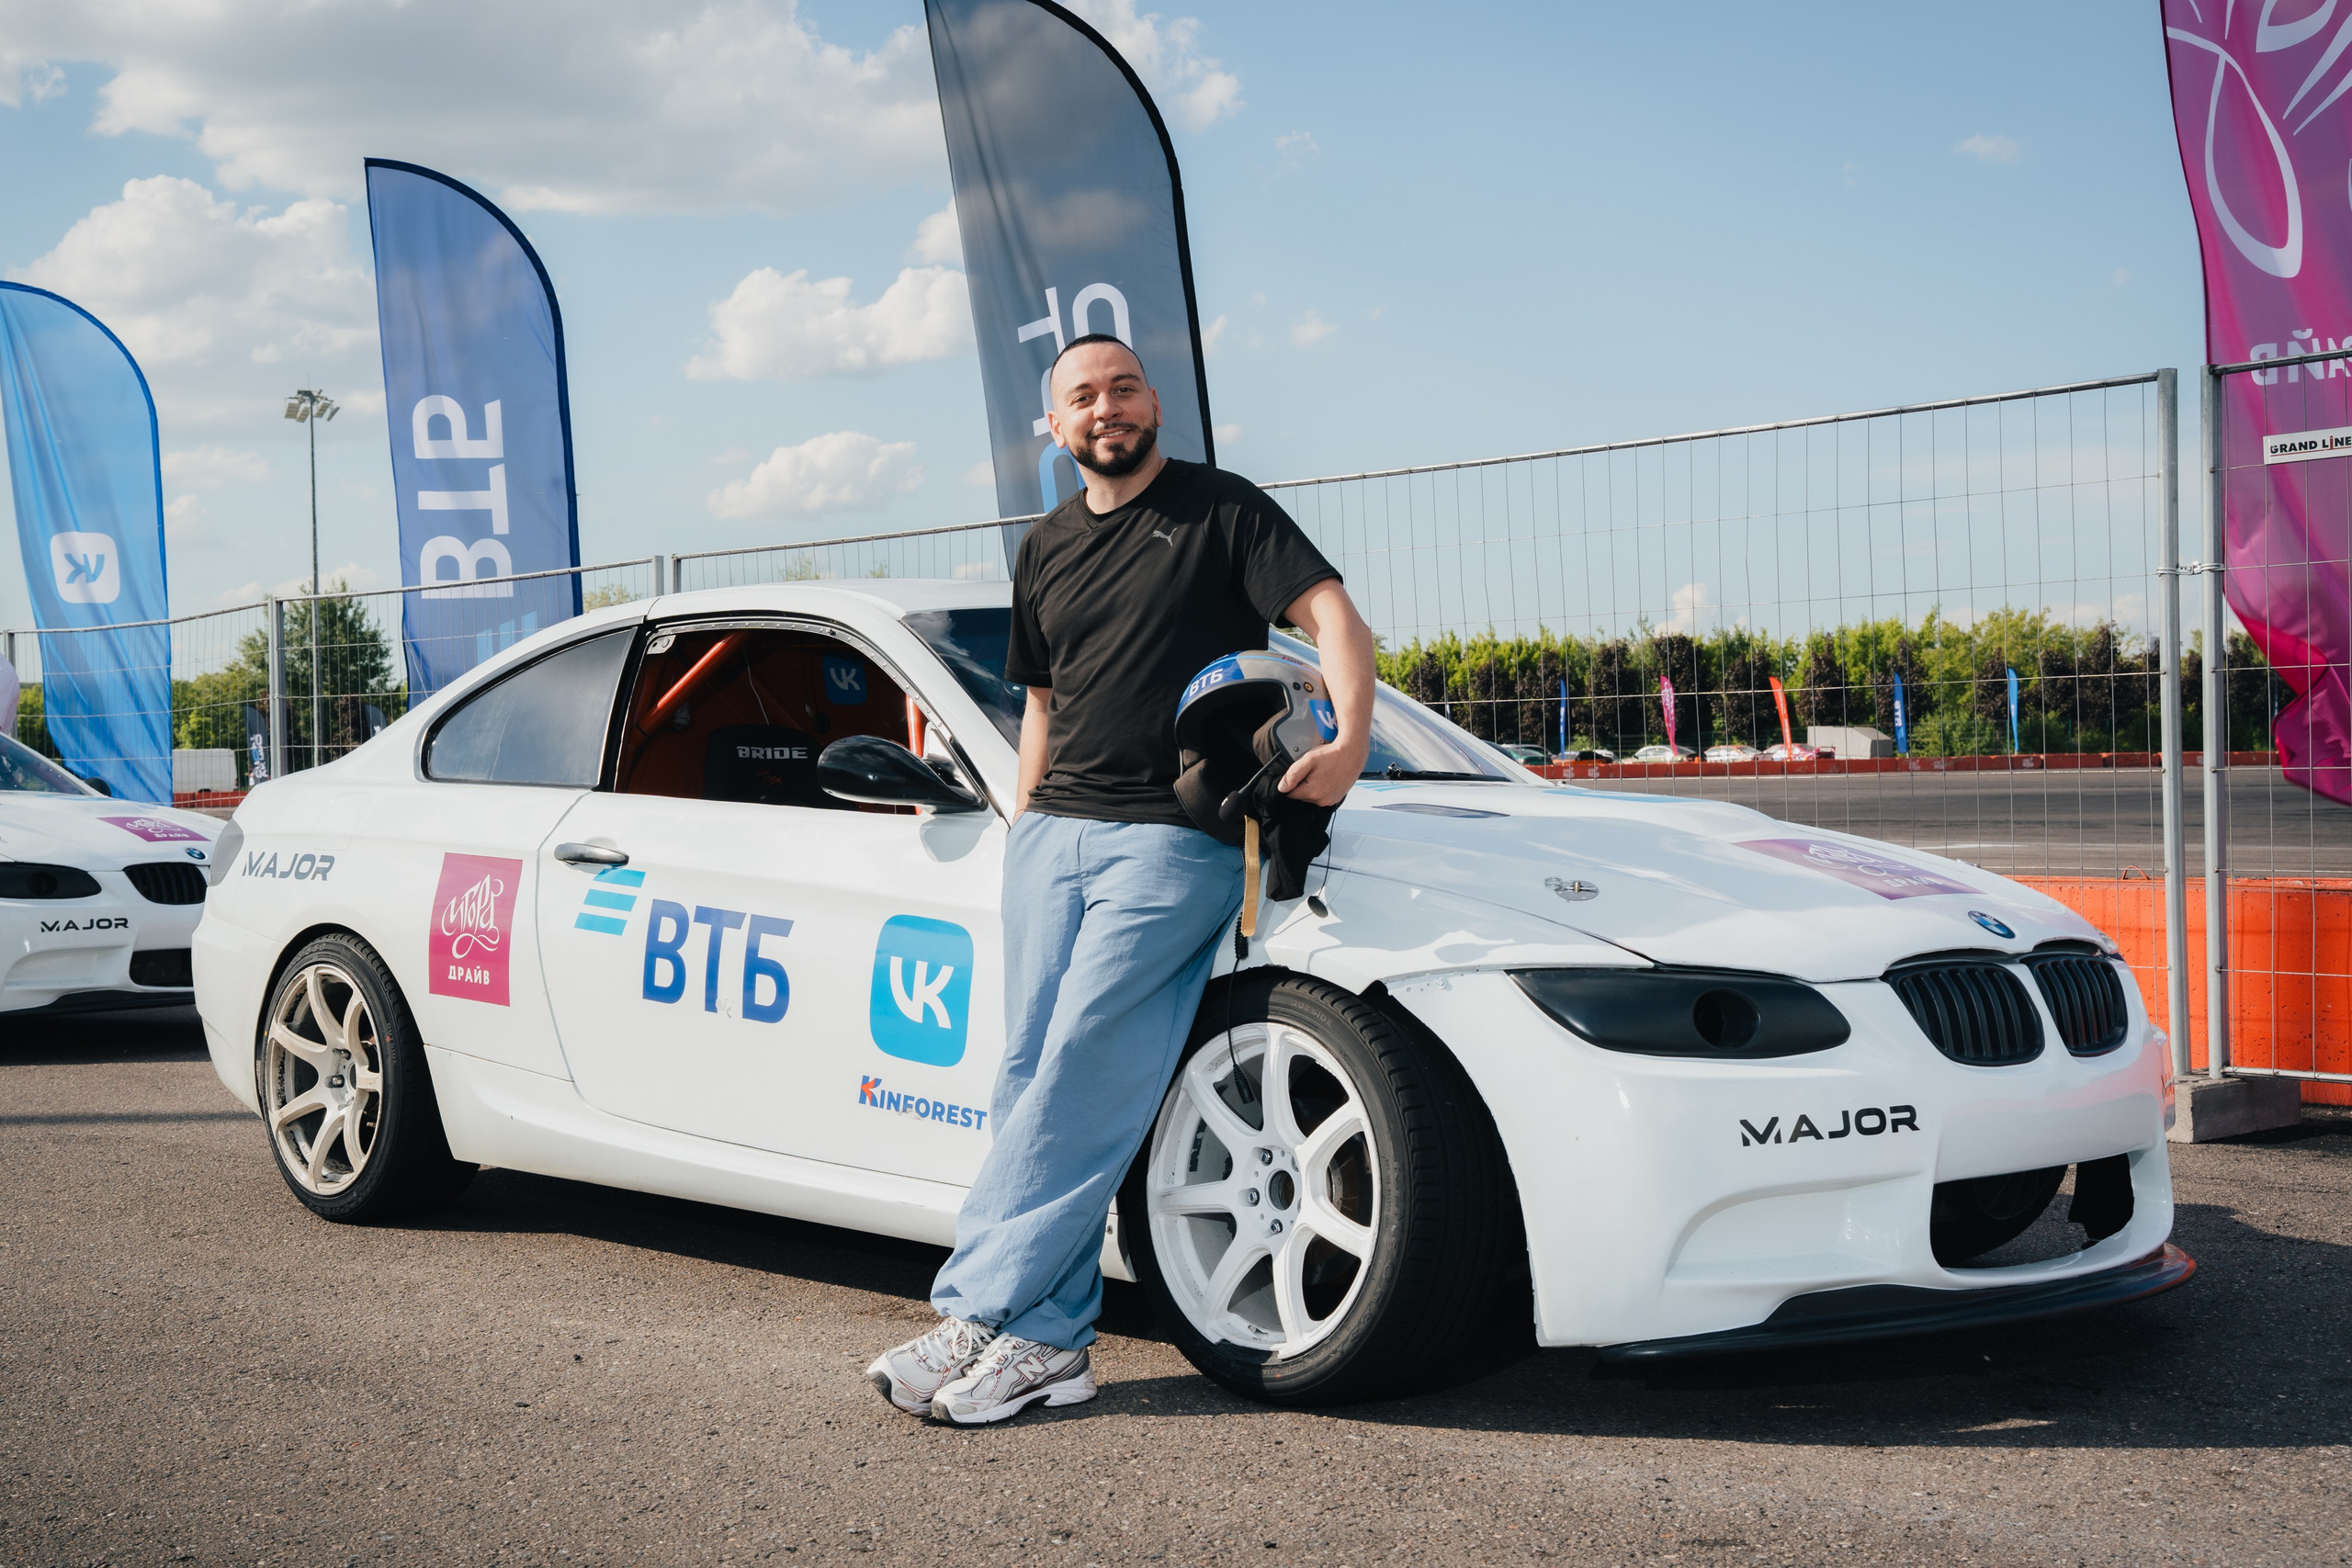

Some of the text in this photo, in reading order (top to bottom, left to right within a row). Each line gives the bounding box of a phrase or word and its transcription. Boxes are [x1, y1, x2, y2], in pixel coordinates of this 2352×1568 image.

[2269, 440, 2318, 455] GRAND
[829, 667, 861, 691] VK
[1189, 668, 1224, 697] ВТБ
[736, 745, 808, 760] BRIDE
[242, 851, 335, 882] MAJOR
[40, 917, 130, 933] MAJOR
[642, 898, 795, 1024] ВТБ
[447, 964, 490, 986] ДРАЙВ
[889, 955, 955, 1030] VK
[1739, 1104, 1921, 1147] MAJOR
